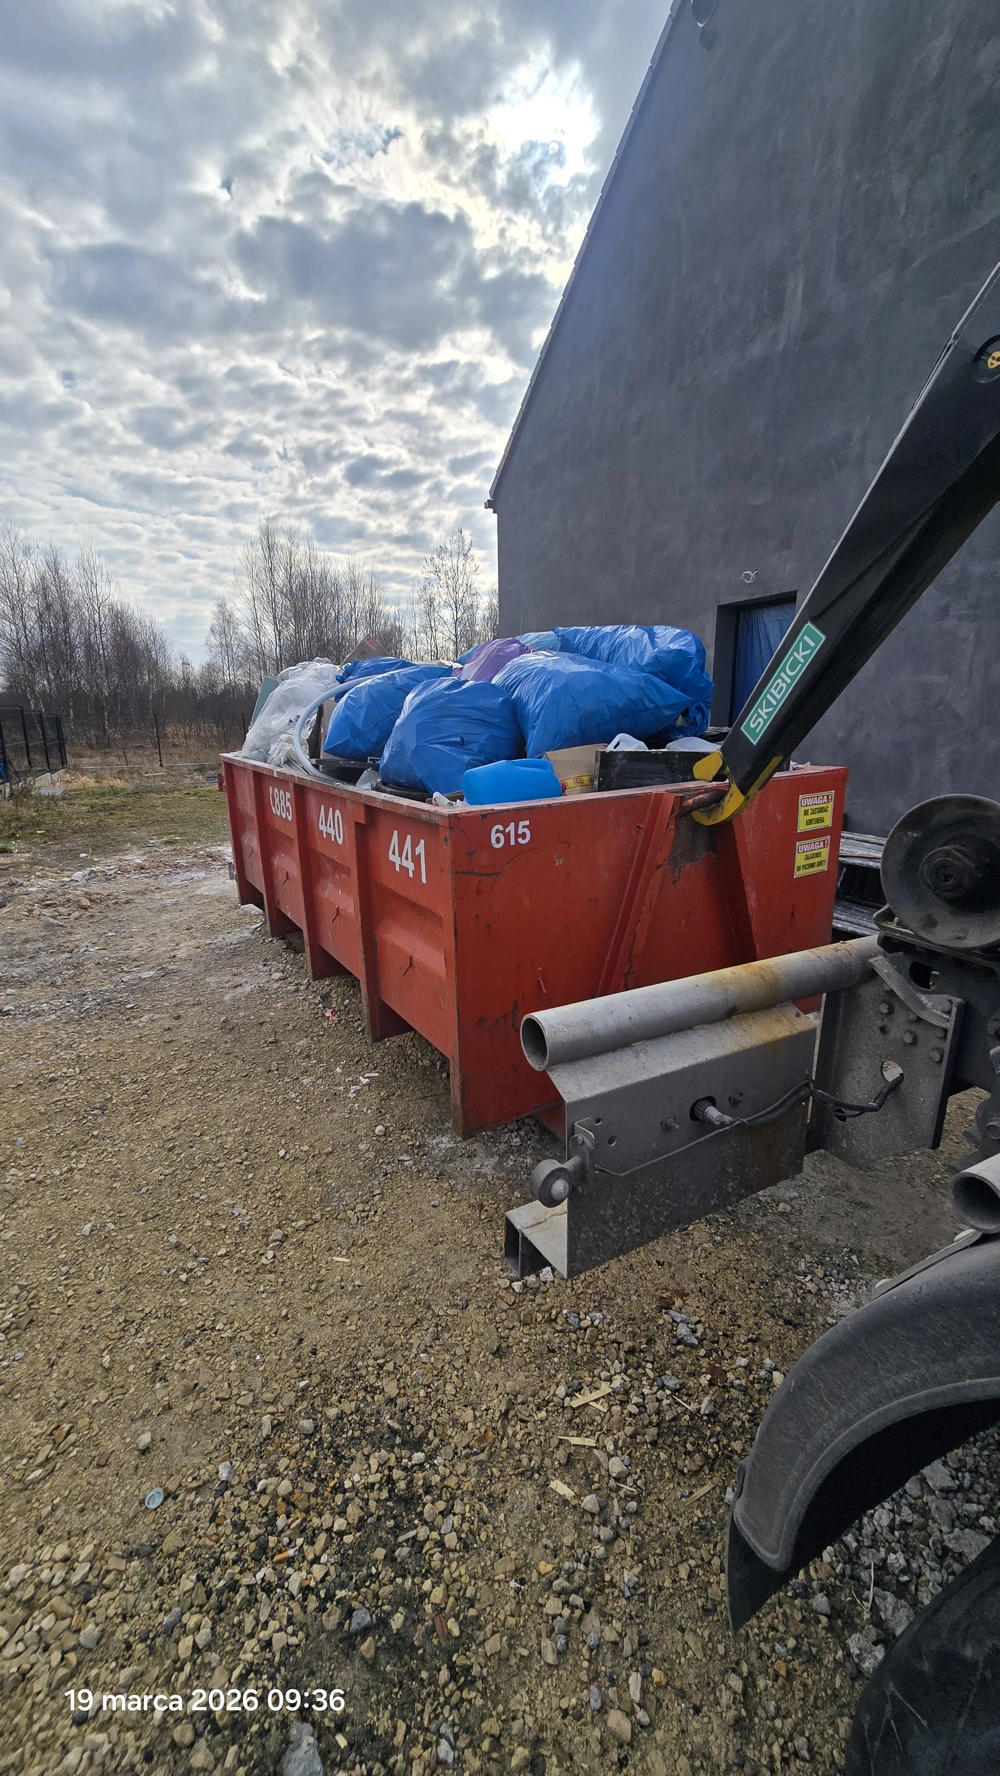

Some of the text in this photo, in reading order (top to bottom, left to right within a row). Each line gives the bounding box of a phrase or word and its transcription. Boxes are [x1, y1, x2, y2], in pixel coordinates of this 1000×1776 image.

[749, 635, 816, 733] SKIBICKI
[319, 805, 343, 845] 440
[389, 830, 427, 884] 441
[490, 820, 531, 849] 615
